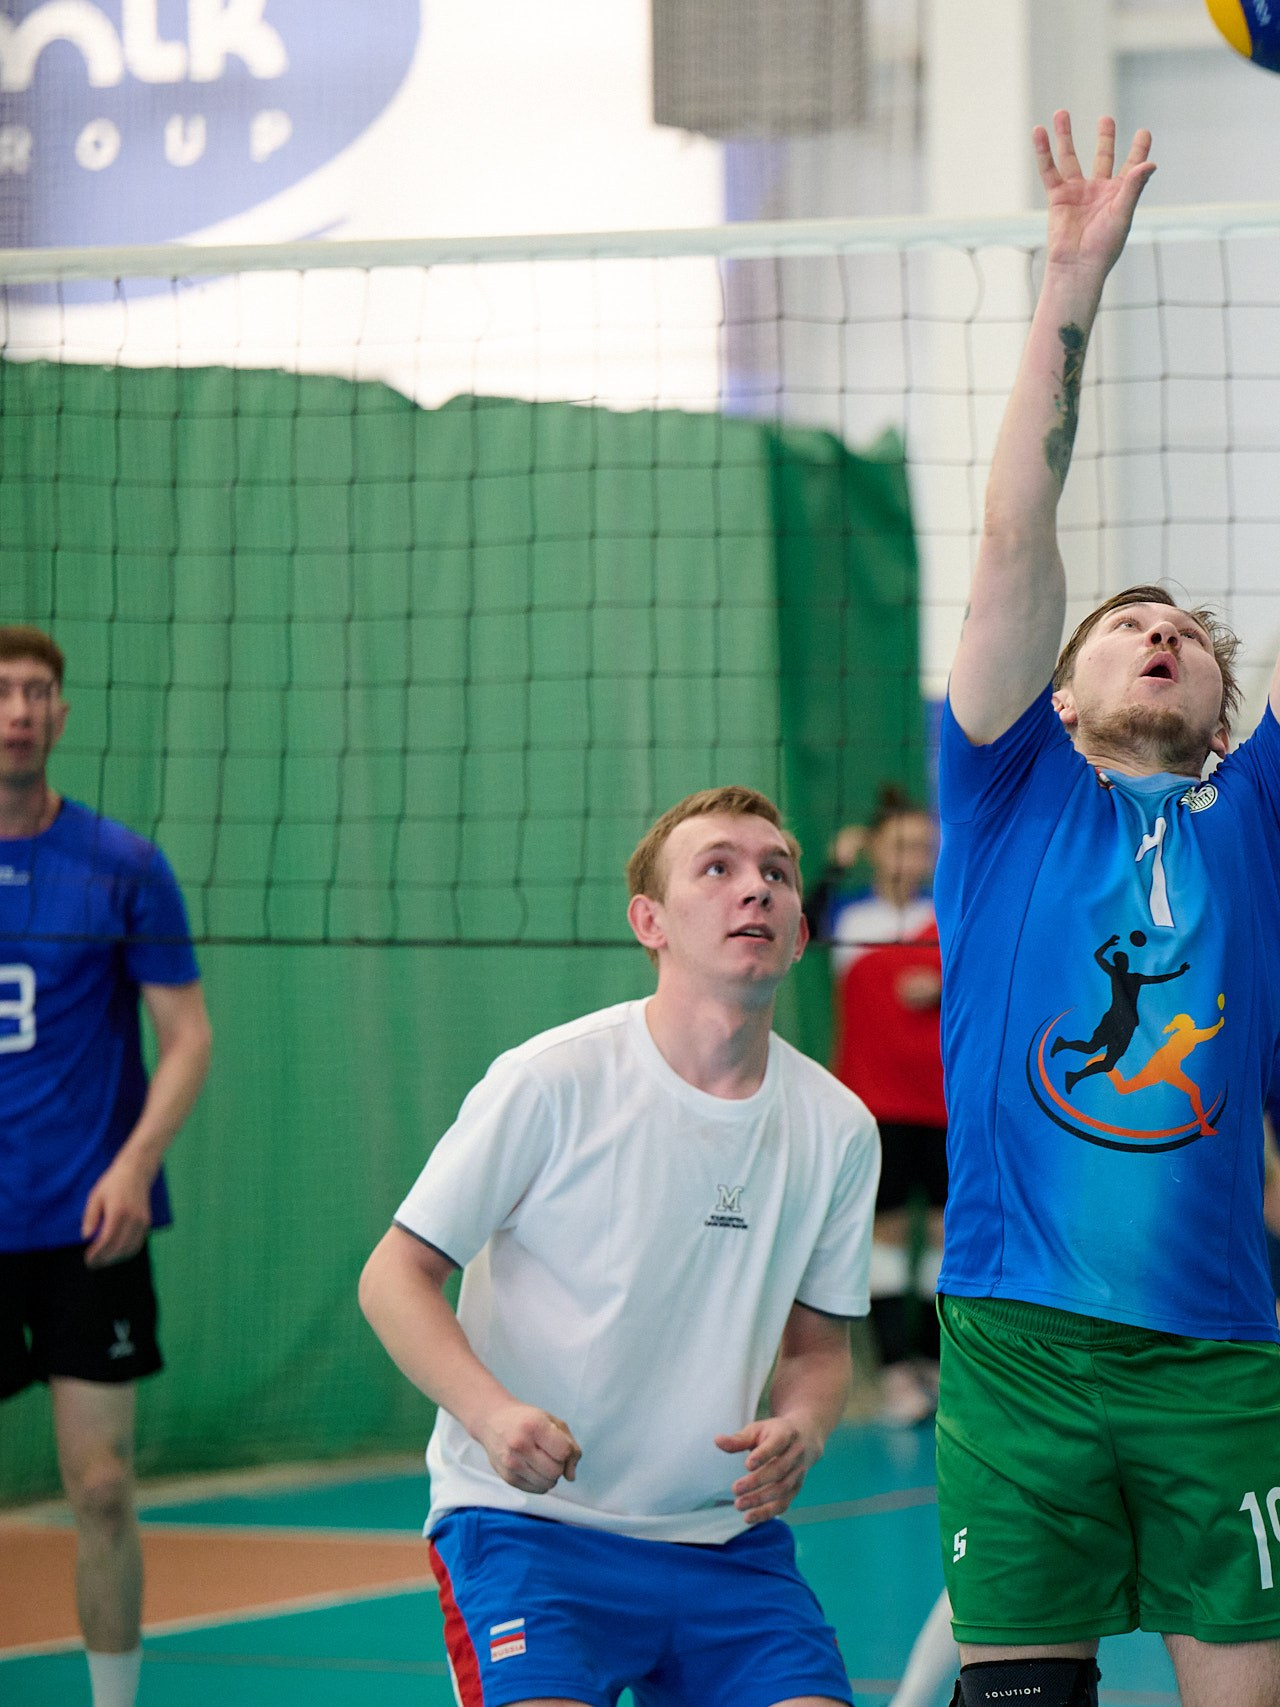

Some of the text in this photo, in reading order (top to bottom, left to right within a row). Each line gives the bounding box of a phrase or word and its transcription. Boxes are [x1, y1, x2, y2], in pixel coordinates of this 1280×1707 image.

[715, 1184, 744, 1213] M
[491, 1644, 524, 1659] RUSSIA
[984, 1686, 1041, 1699] SOLUTION
